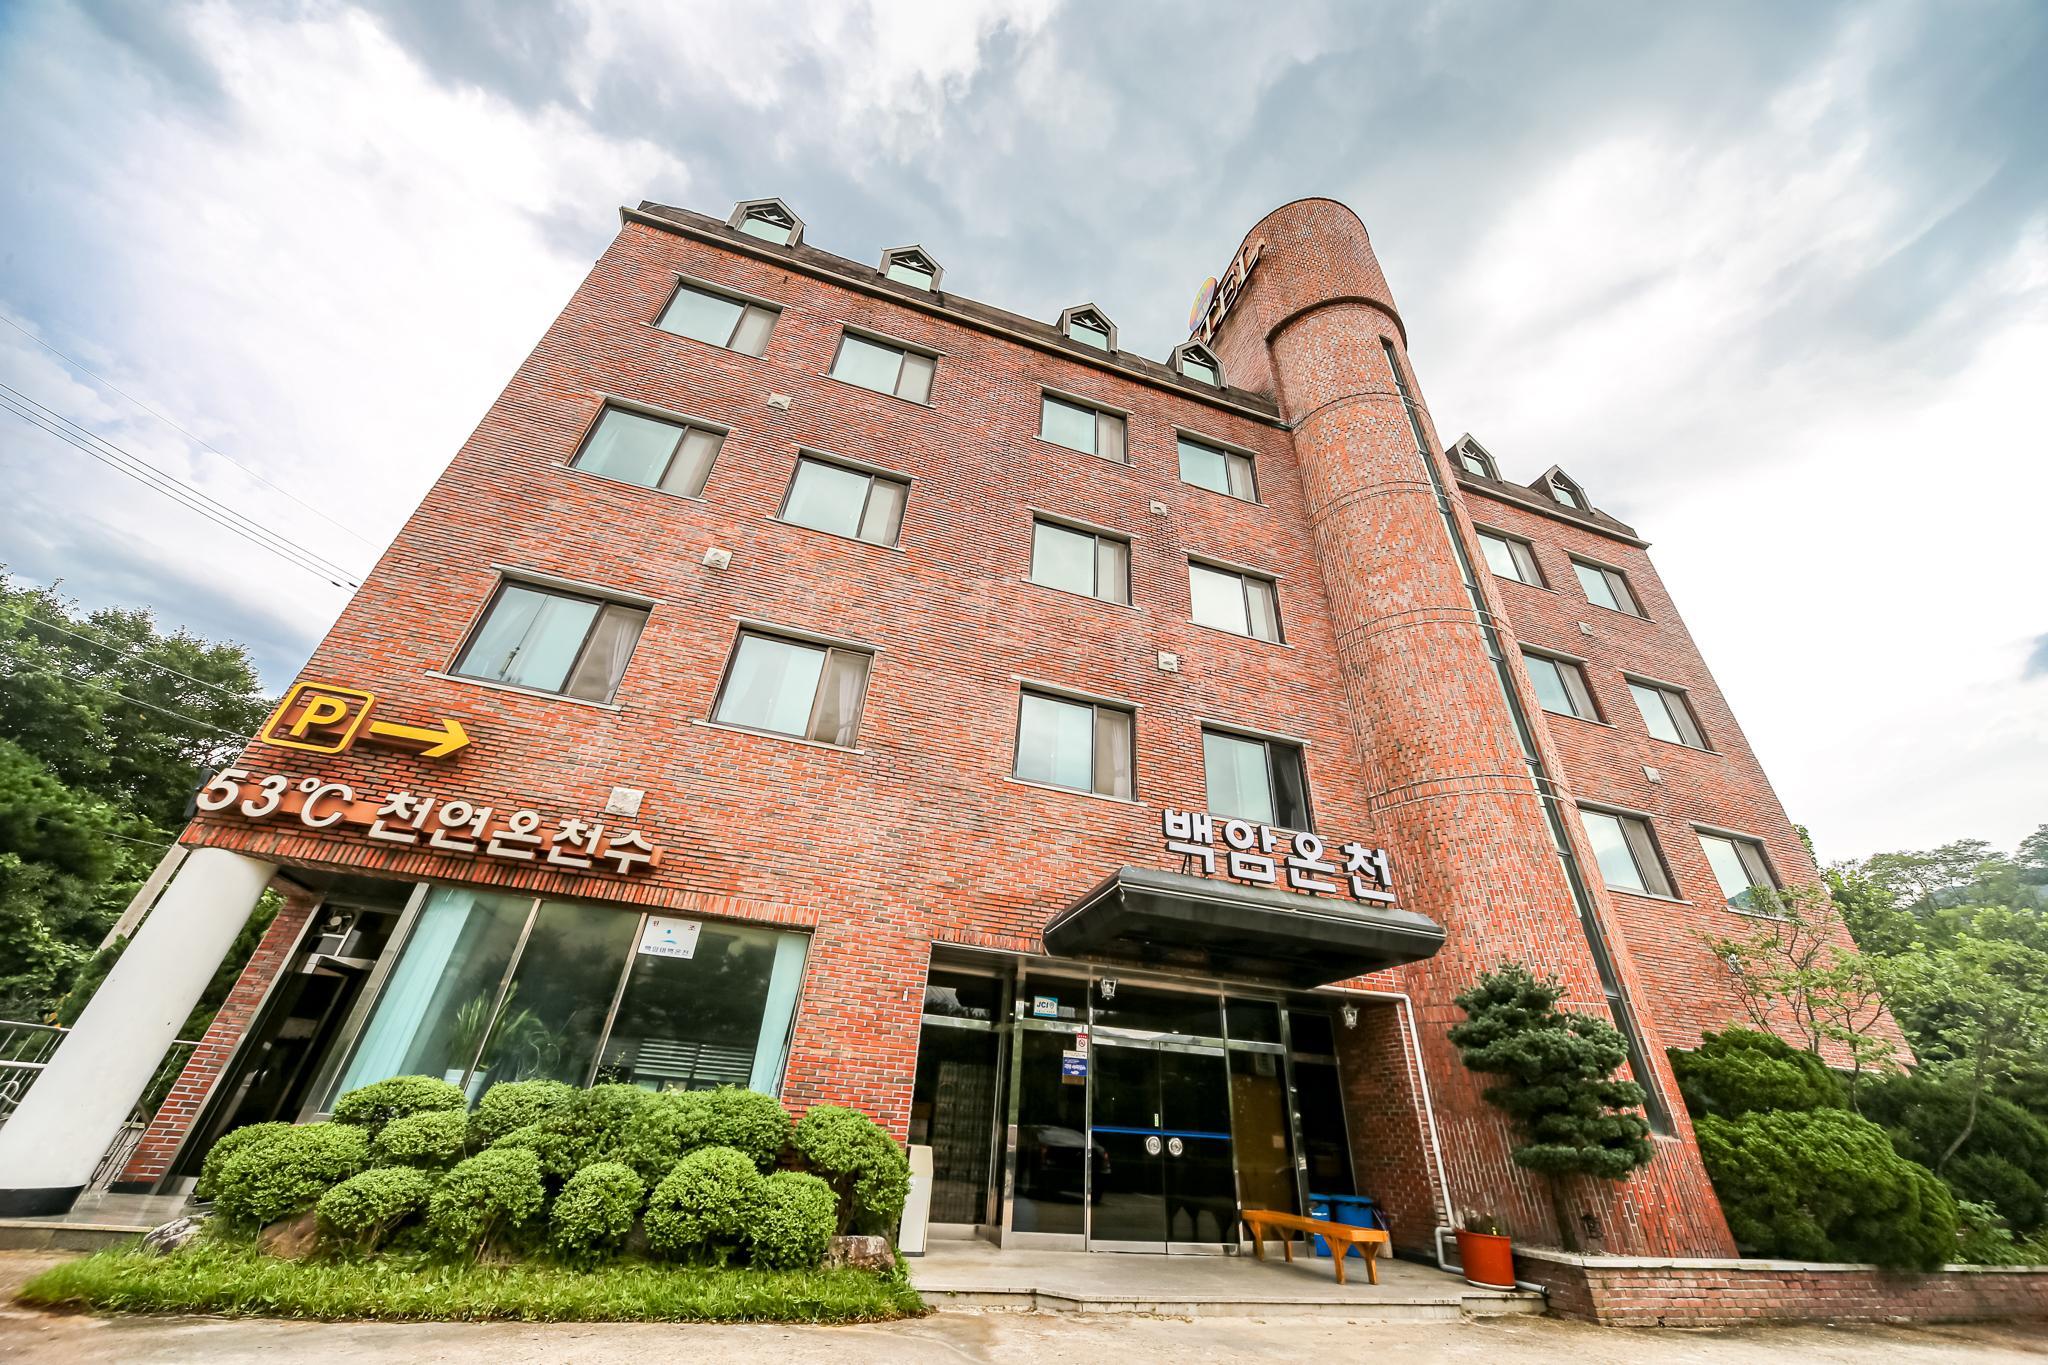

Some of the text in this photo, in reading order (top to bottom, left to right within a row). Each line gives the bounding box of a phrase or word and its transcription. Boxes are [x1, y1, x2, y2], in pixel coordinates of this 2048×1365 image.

[288, 695, 349, 739] P
[367, 789, 653, 875] 천연온천수
[1161, 808, 1397, 903] 백암온천
